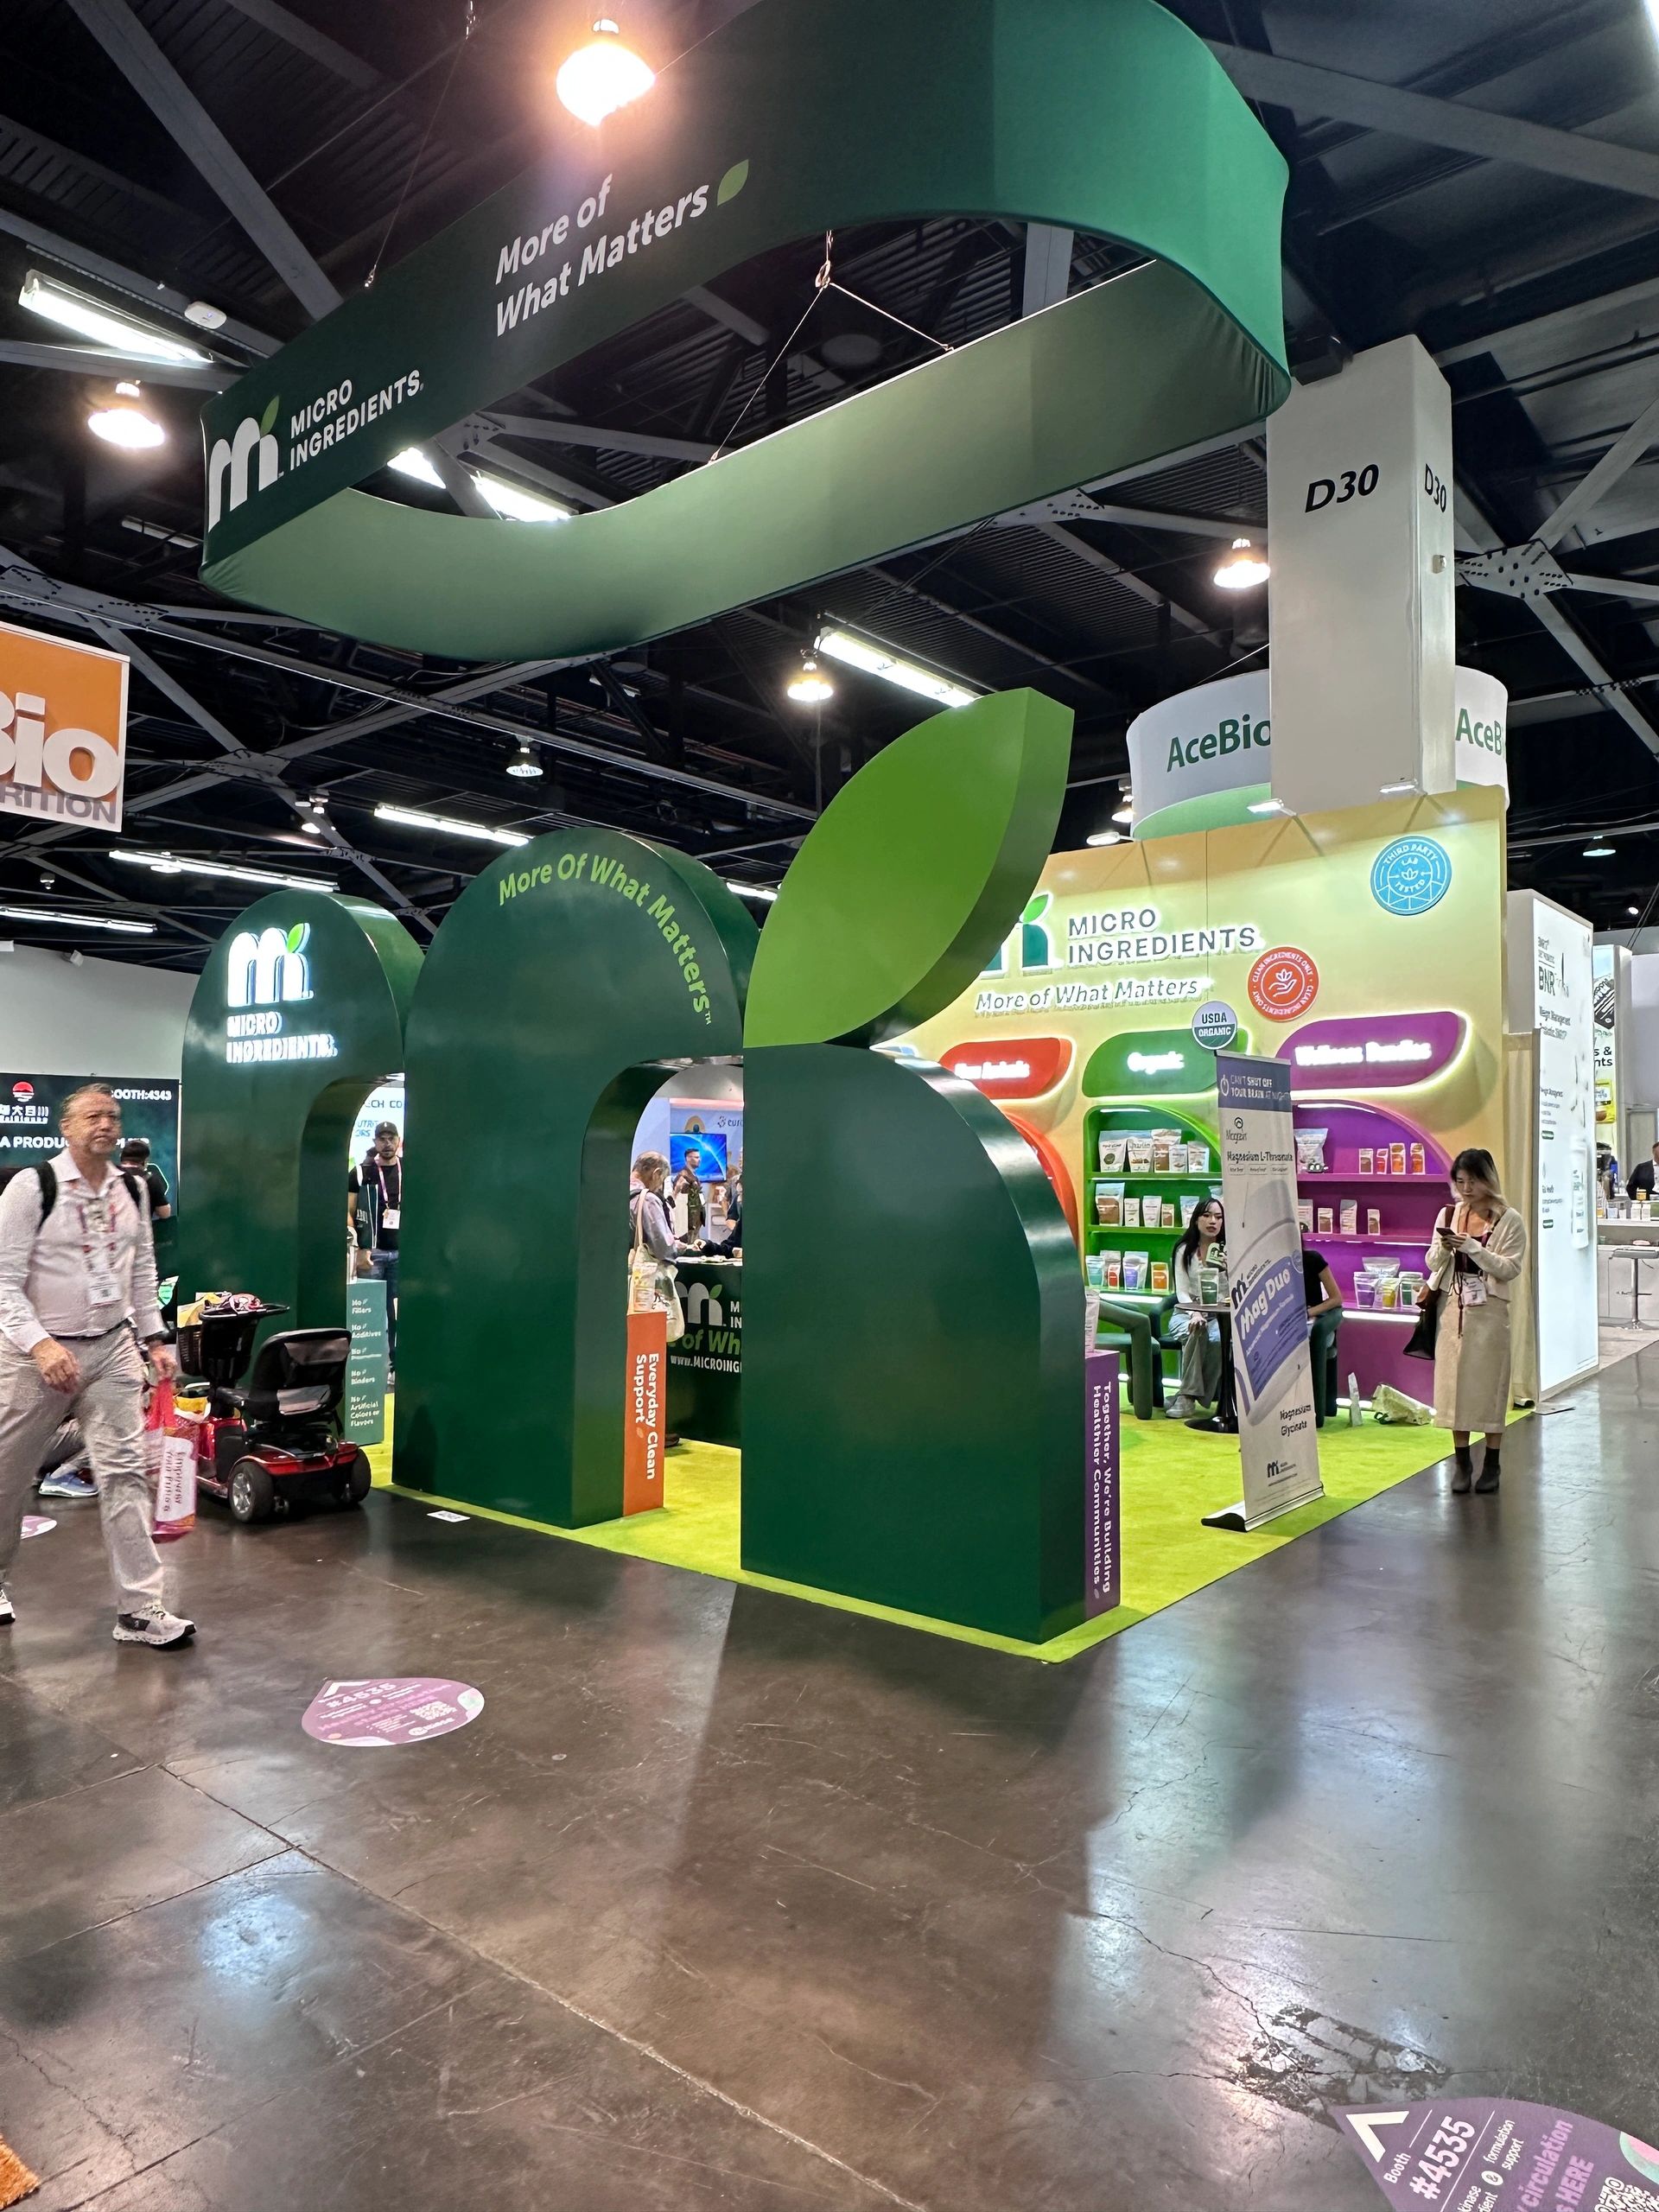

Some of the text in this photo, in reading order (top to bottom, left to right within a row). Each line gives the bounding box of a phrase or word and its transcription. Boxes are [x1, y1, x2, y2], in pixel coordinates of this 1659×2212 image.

[495, 173, 613, 285] More of
[497, 184, 709, 337] What Matters
[290, 378, 353, 439] MICRO
[1305, 464, 1379, 513] D30
[1424, 463, 1447, 512] D30
[1455, 708, 1504, 756] AceB
[0, 783, 117, 824] RITION
[1383, 843, 1438, 864] THIRD PARTY
[499, 864, 552, 906] More
[557, 853, 588, 880] Of
[590, 855, 650, 907] What
[1395, 879, 1425, 893] TESTED
[1069, 908, 1156, 937] MICRO
[1069, 927, 1255, 963] INGREDIENTS
[976, 978, 1198, 1010] More of What Matters
[1252, 963, 1266, 982] CLEAN
[1301, 960, 1313, 976] ONLY
[226, 1012, 283, 1037] MICRO
[1198, 1027, 1231, 1037] ORGANIC
[1202, 1012, 1227, 1024] USDA
[1604, 1046, 1612, 1056] &
[1241, 1291, 1268, 1340] Mag
[1265, 1268, 1291, 1300] Duo
[682, 1329, 741, 1356] of Wh
[633, 1354, 646, 1424] Support
[645, 1353, 659, 1480] Everyday Clean
[1093, 1385, 1102, 1585] Healthier Communities
[1103, 1382, 1112, 1593] Together, We're Building
[1409, 2115, 1475, 2200] #4535
[1483, 2120, 1516, 2164] formulation
[1502, 2138, 1524, 2171] support
[1521, 2120, 1573, 2207] circulation
[1383, 2152, 1411, 2184] Booth
[1555, 2155, 1595, 2207] HERE
